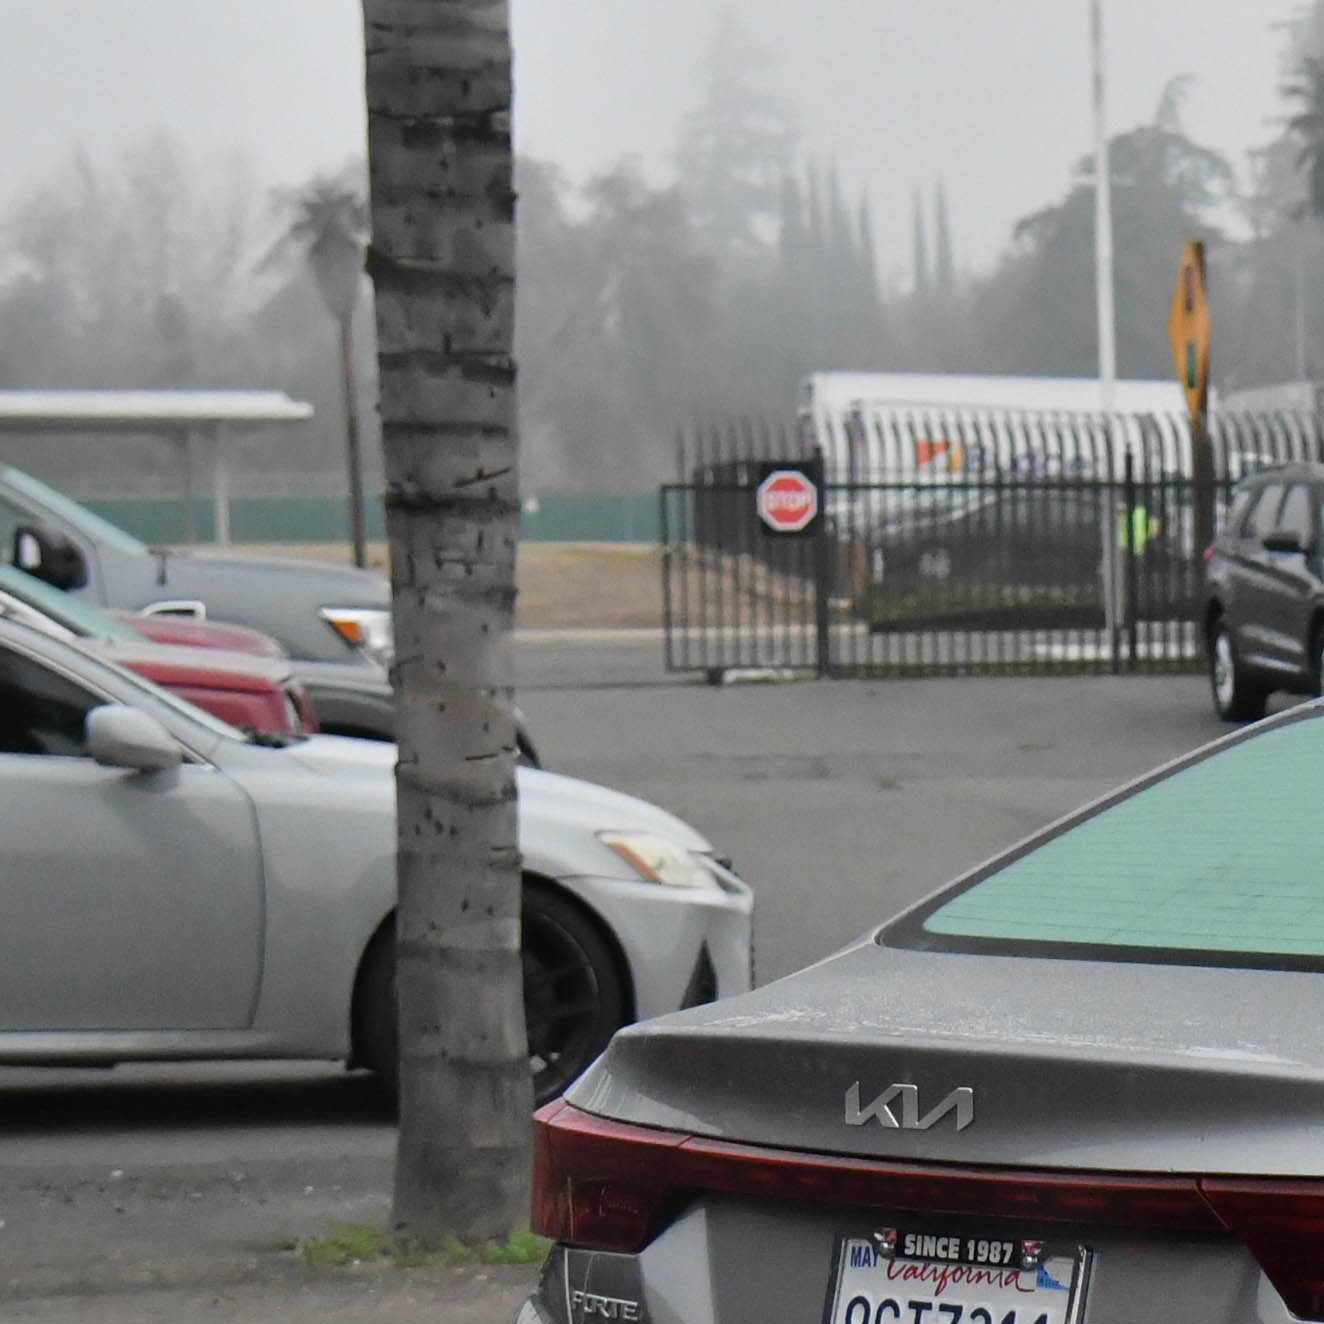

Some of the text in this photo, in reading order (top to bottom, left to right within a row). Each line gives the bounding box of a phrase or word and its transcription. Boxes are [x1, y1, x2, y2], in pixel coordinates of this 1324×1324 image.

[767, 490, 810, 511] STOP
[845, 1081, 974, 1131] KIA
[850, 1246, 879, 1268] MAY
[904, 1233, 1014, 1264] SINCE 1987
[886, 1258, 1035, 1297] California
[572, 1290, 639, 1321] FORTE
